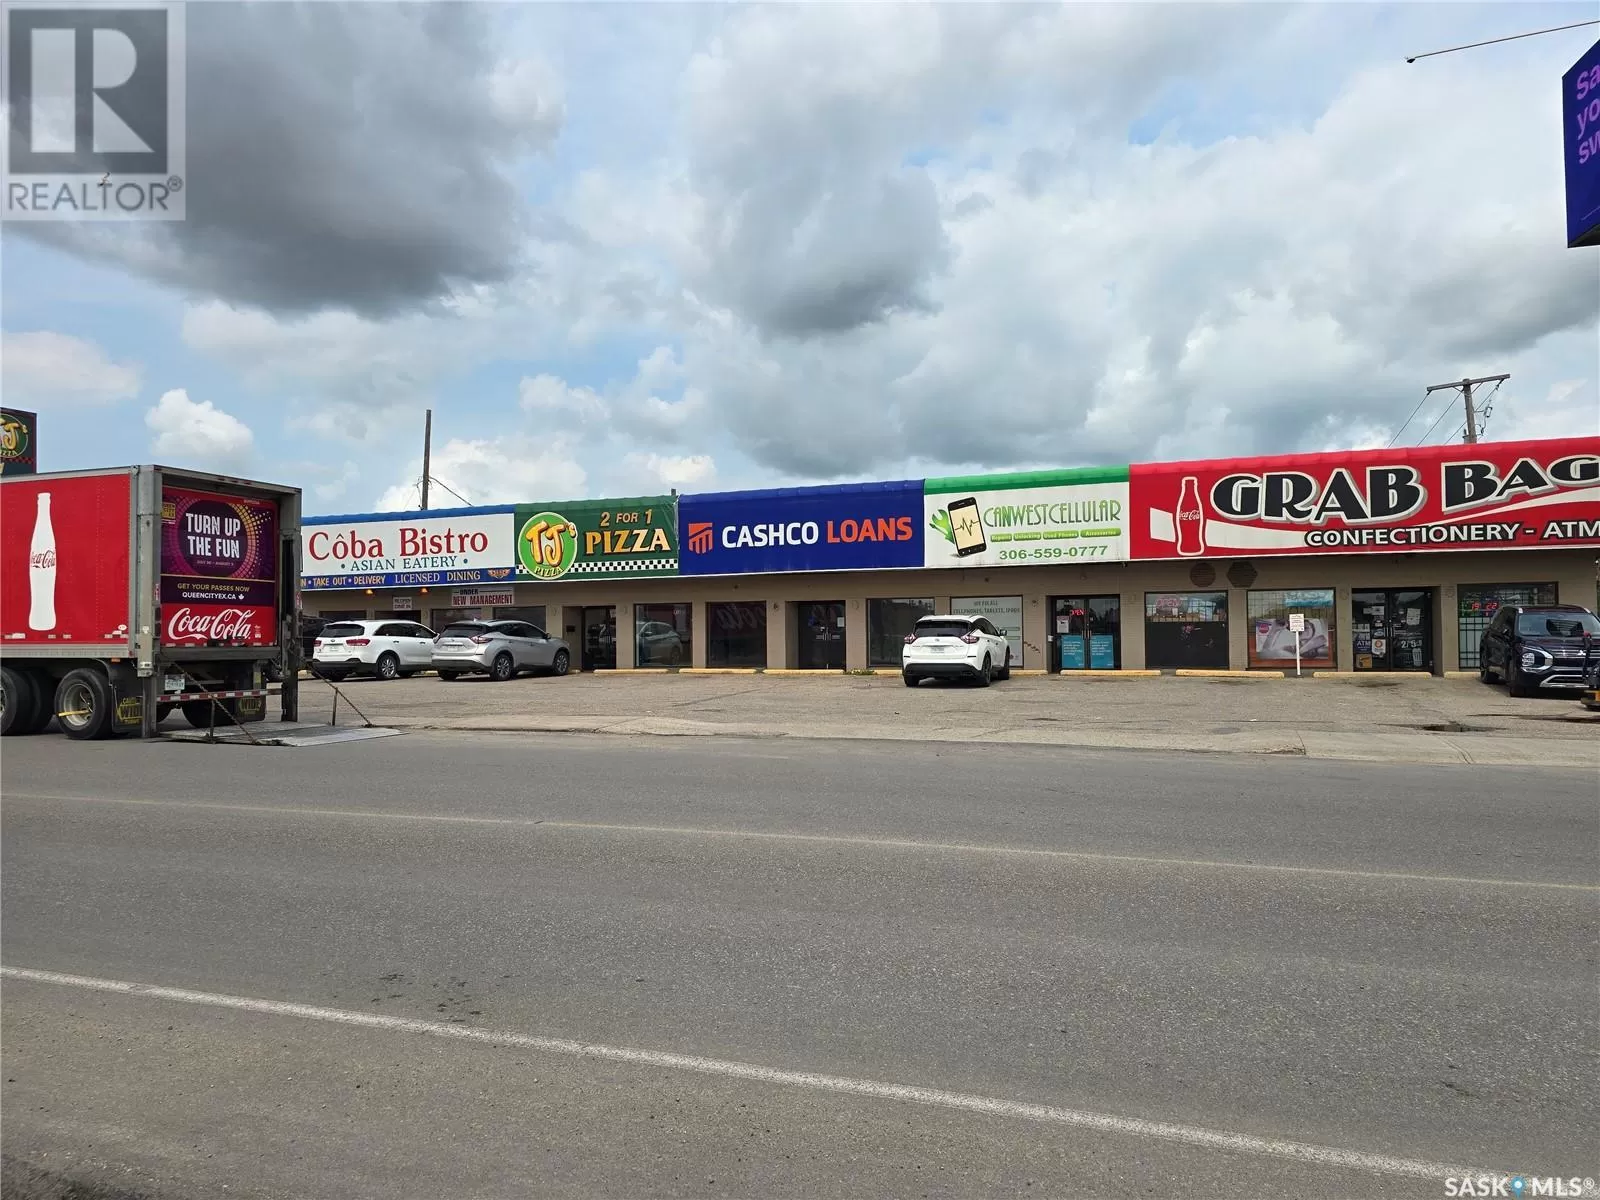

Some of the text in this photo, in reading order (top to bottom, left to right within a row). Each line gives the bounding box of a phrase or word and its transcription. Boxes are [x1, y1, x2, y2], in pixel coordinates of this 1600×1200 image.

[1210, 454, 1600, 525] GRAB BAG
[185, 513, 241, 536] TURN UP
[600, 509, 652, 527] 2 FOR 1
[983, 500, 1121, 528] CANWESTCELLULAR
[308, 527, 488, 561] Côba Bistro
[585, 528, 671, 555] PIZZA
[721, 517, 913, 548] CASHCO LOANS
[1306, 523, 1520, 546] CONFECTIONERY
[1543, 520, 1600, 539] ATM
[187, 536, 240, 559] THE FUN
[999, 545, 1108, 560] 306-559-0777
[350, 555, 458, 572] ASIAN EATERY
[534, 566, 563, 577] PIZZA
[177, 582, 250, 593] GET YOUR PASSES NOW
[313, 577, 330, 587] TAKE
[332, 576, 347, 586] OUT
[353, 575, 386, 585] DELIVERY
[395, 573, 440, 584] LICENSED
[447, 571, 481, 582] DINING
[182, 592, 237, 600] QUEENCITYEX.CA
[452, 594, 513, 606] NEW MANAGEMENT
[168, 607, 256, 640] Coca-Cola
